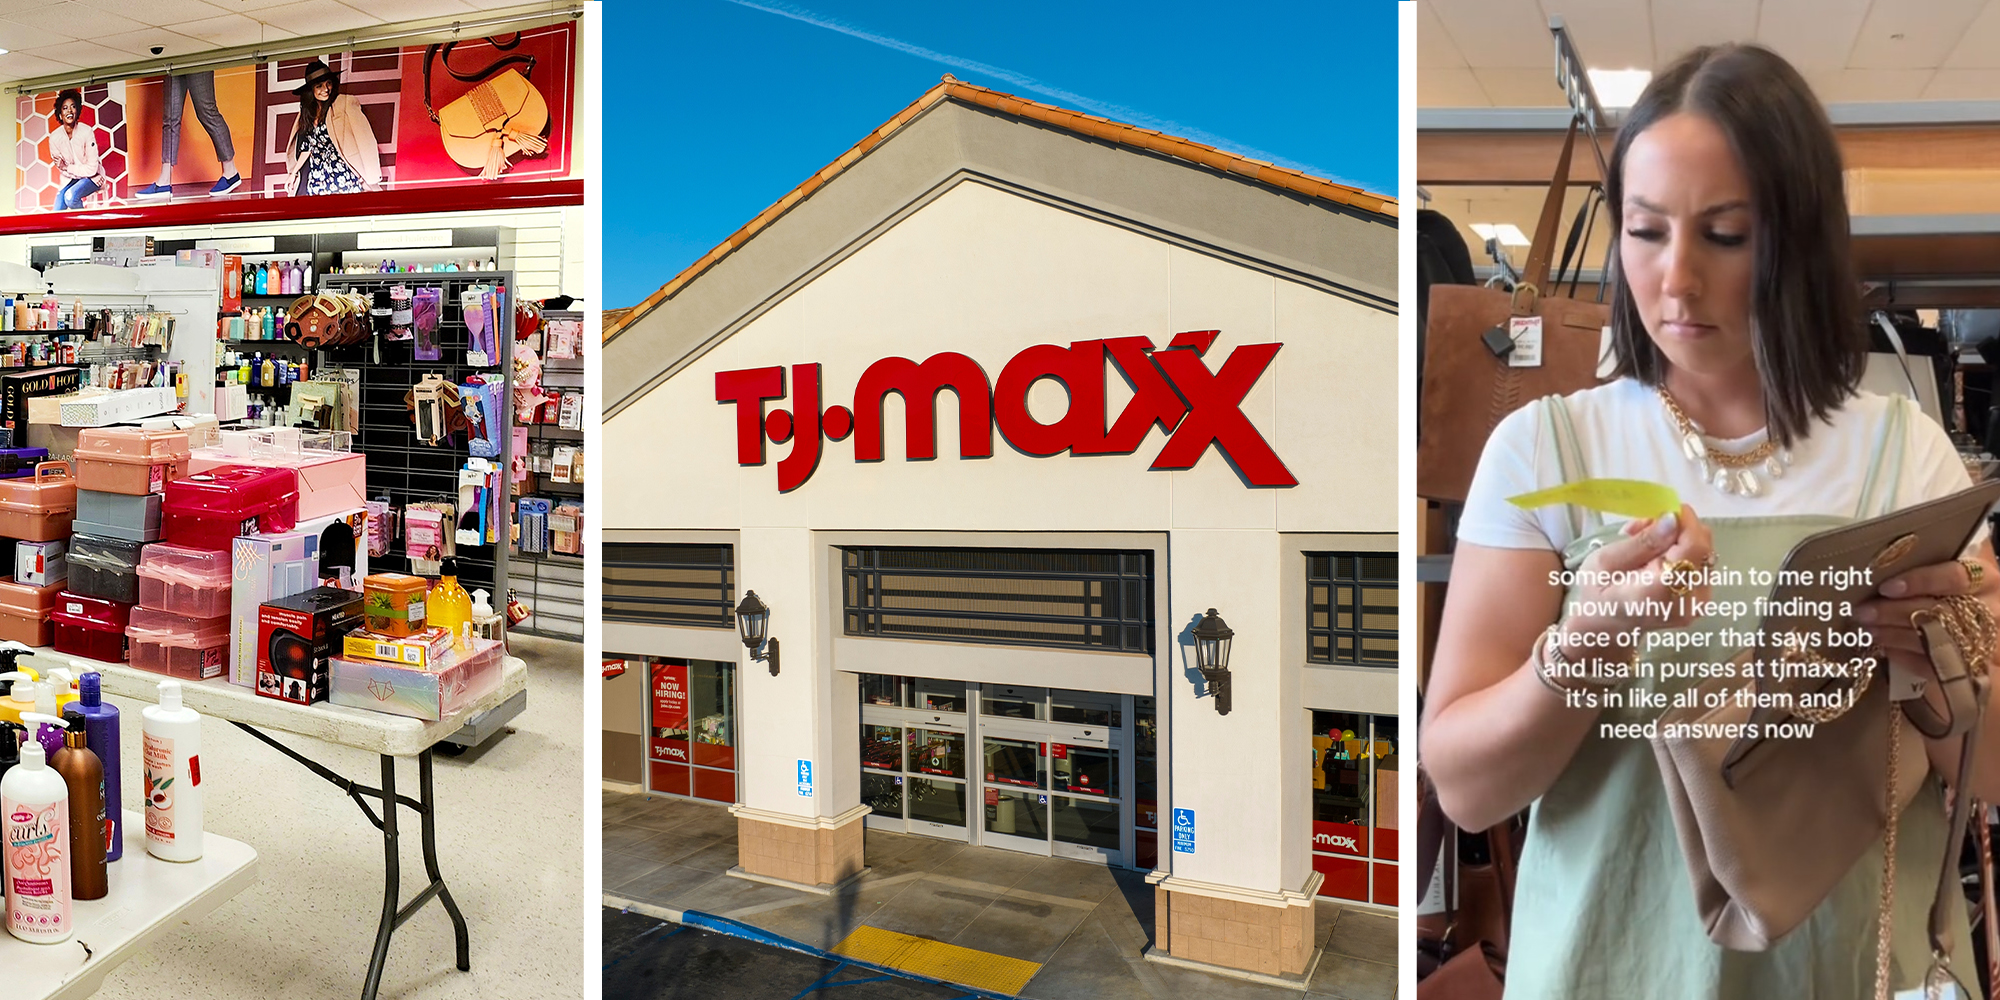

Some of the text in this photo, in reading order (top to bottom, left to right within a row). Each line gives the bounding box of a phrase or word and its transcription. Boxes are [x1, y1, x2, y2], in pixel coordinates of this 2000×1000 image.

[22, 379, 49, 394] GOLD
[56, 373, 76, 387] HOT
[7, 385, 15, 419] GOLD
[660, 682, 680, 691] NOW
[655, 689, 686, 700] HIRING!
[10, 816, 50, 841] curls
[1174, 825, 1195, 834] PARKING
[1178, 832, 1191, 840] ONLY
